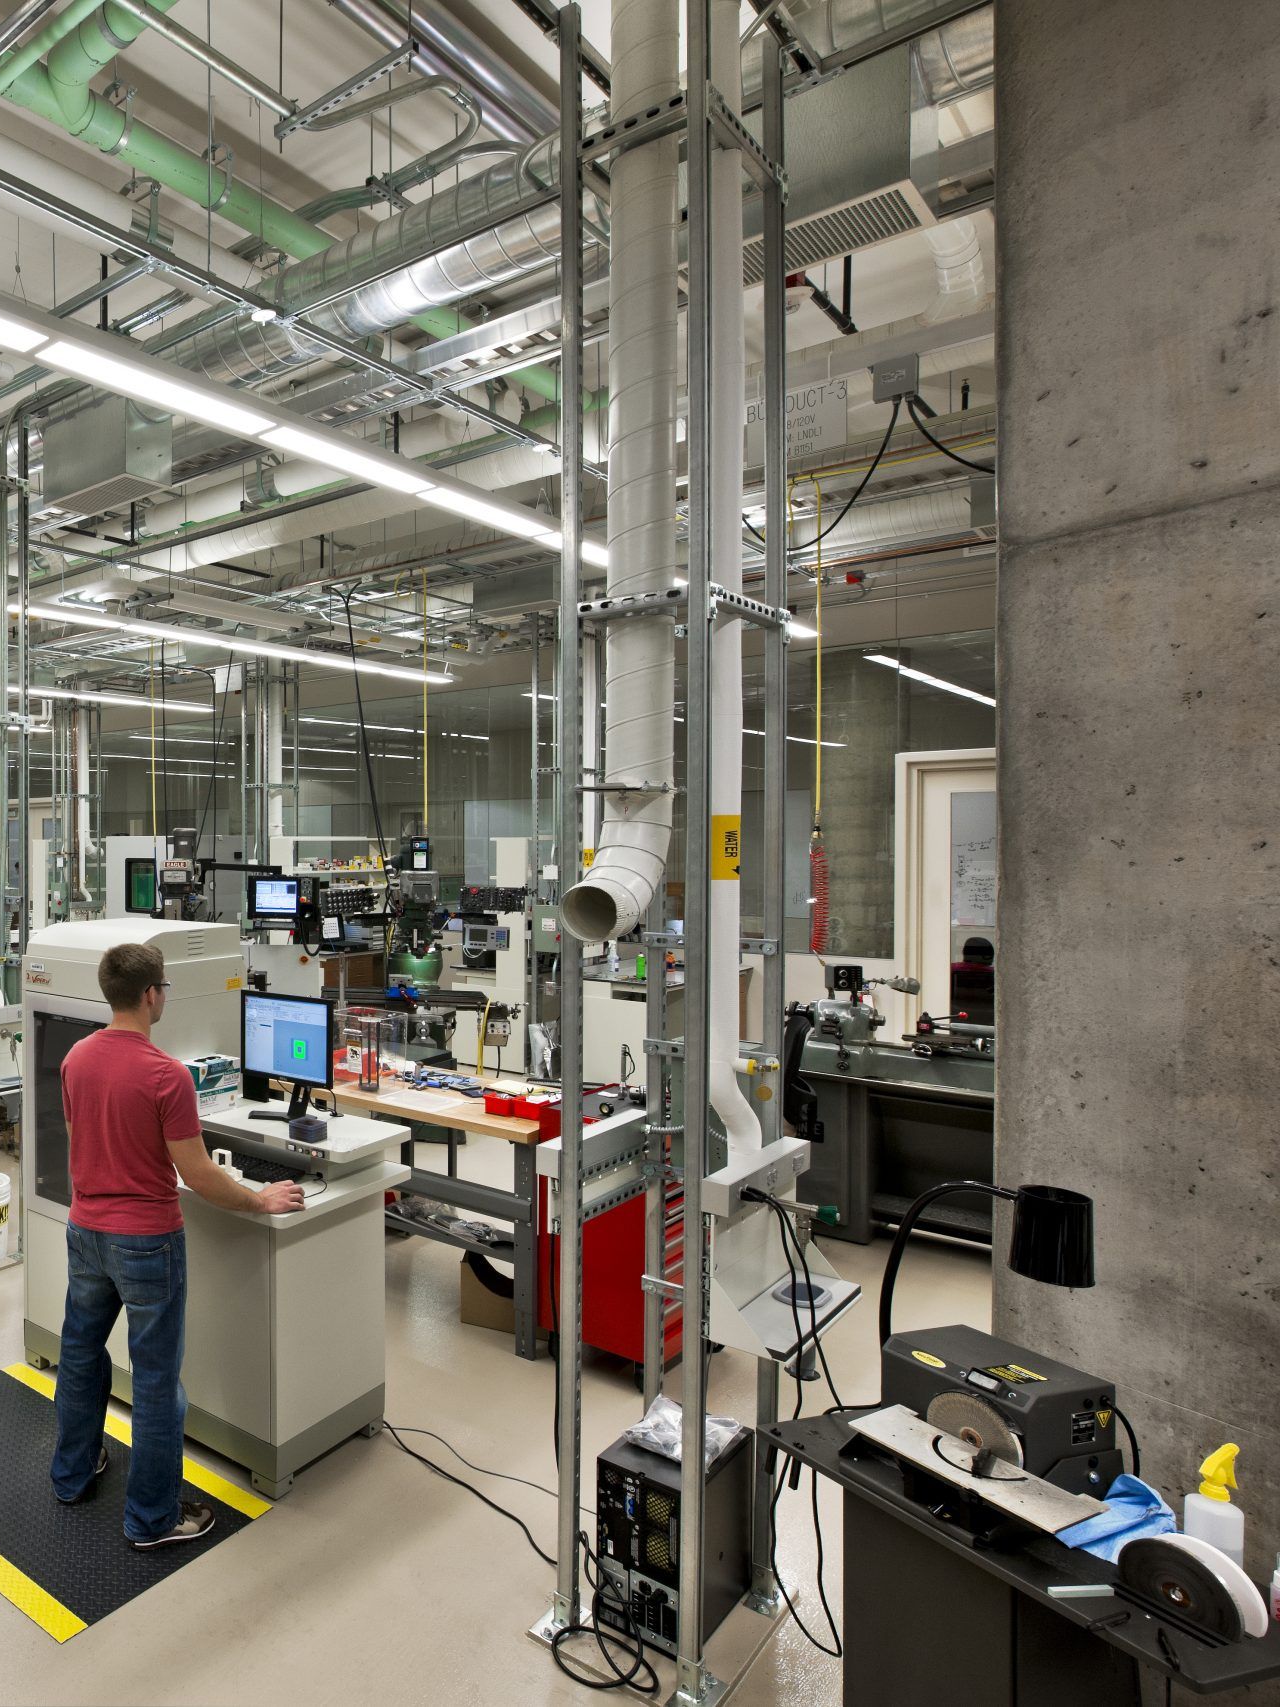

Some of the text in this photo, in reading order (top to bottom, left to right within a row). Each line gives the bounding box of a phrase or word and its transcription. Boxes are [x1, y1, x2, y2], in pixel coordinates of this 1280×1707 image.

[747, 380, 847, 424] BU DUCT-3
[724, 830, 738, 858] WATER
